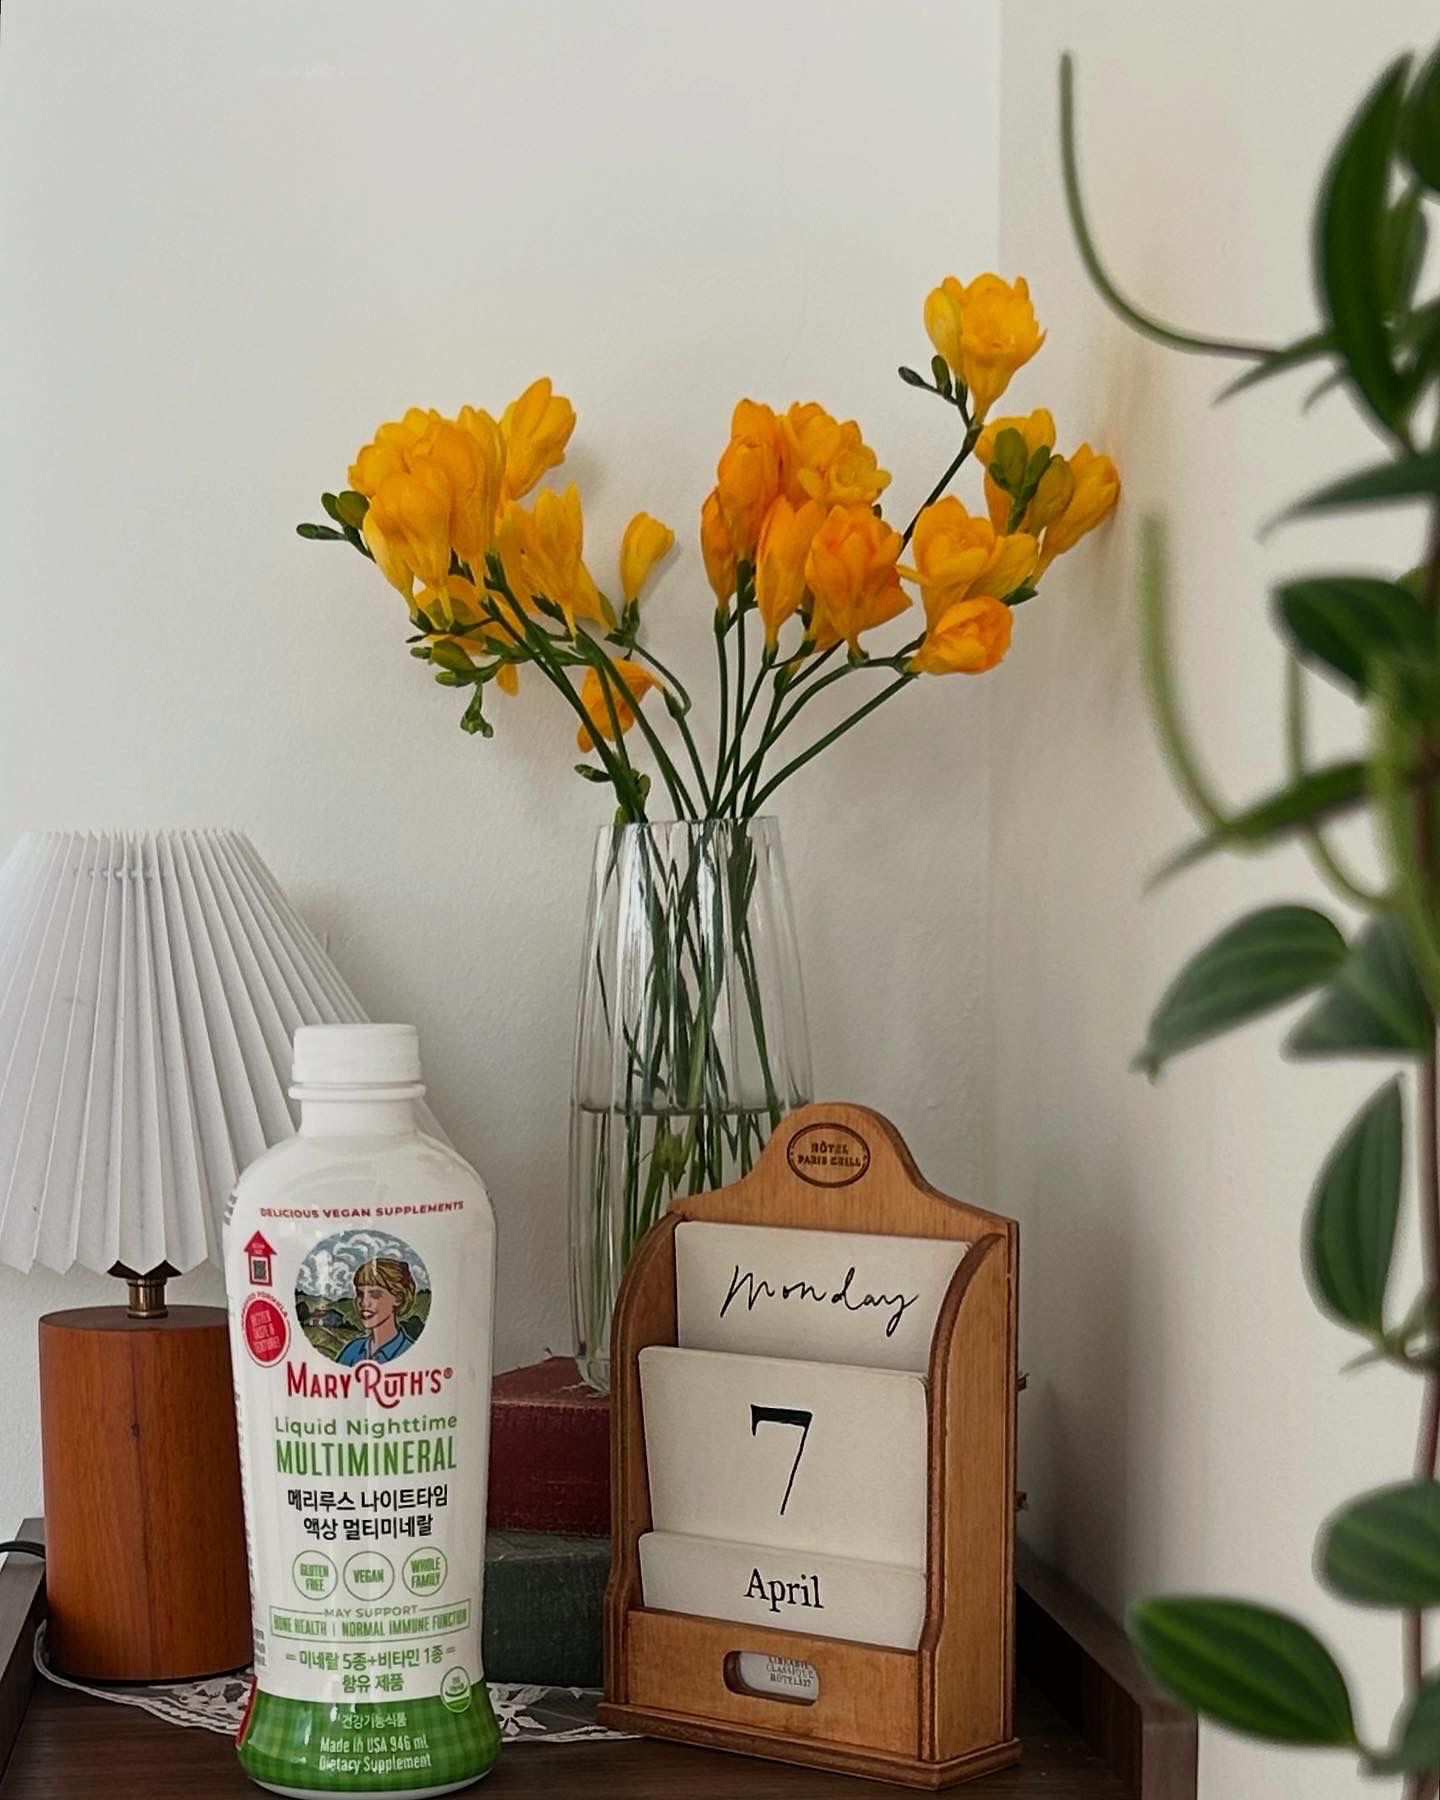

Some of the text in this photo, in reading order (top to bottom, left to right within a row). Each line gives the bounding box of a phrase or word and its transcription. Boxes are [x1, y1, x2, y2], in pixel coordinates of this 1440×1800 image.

[260, 1201, 464, 1218] DELICIOUS VEGAN SUPPLEMENTS
[719, 1266, 919, 1337] Monday
[275, 1415, 457, 1439] Liquid Nighttime
[276, 1436, 457, 1477] MULTIMINERAL
[750, 1403, 813, 1516] 7
[288, 1484, 448, 1512] 메리루스 나이트타임
[303, 1514, 433, 1541] 액상 멀티미네랄
[300, 1563, 329, 1578] GLUTEN
[410, 1557, 441, 1573] WHOLE
[305, 1578, 326, 1592] FREE
[353, 1569, 384, 1583] VEGAN
[411, 1573, 441, 1588] FAMILY
[744, 1568, 824, 1611] April
[324, 1605, 418, 1618] MAY SUPPORT
[294, 1616, 327, 1636] HEALTH
[342, 1620, 385, 1637] NORMAL
[389, 1615, 429, 1635] IMMUNE
[299, 1650, 339, 1671] 미네랄
[424, 1645, 443, 1664] 1종
[343, 1673, 405, 1693] 함유 제품
[342, 1712, 407, 1729] 건강기능식품
[320, 1736, 350, 1753] Made
[366, 1736, 388, 1753] USA
[389, 1735, 411, 1752] 946
[319, 1753, 432, 1775] Dietary Supplement
